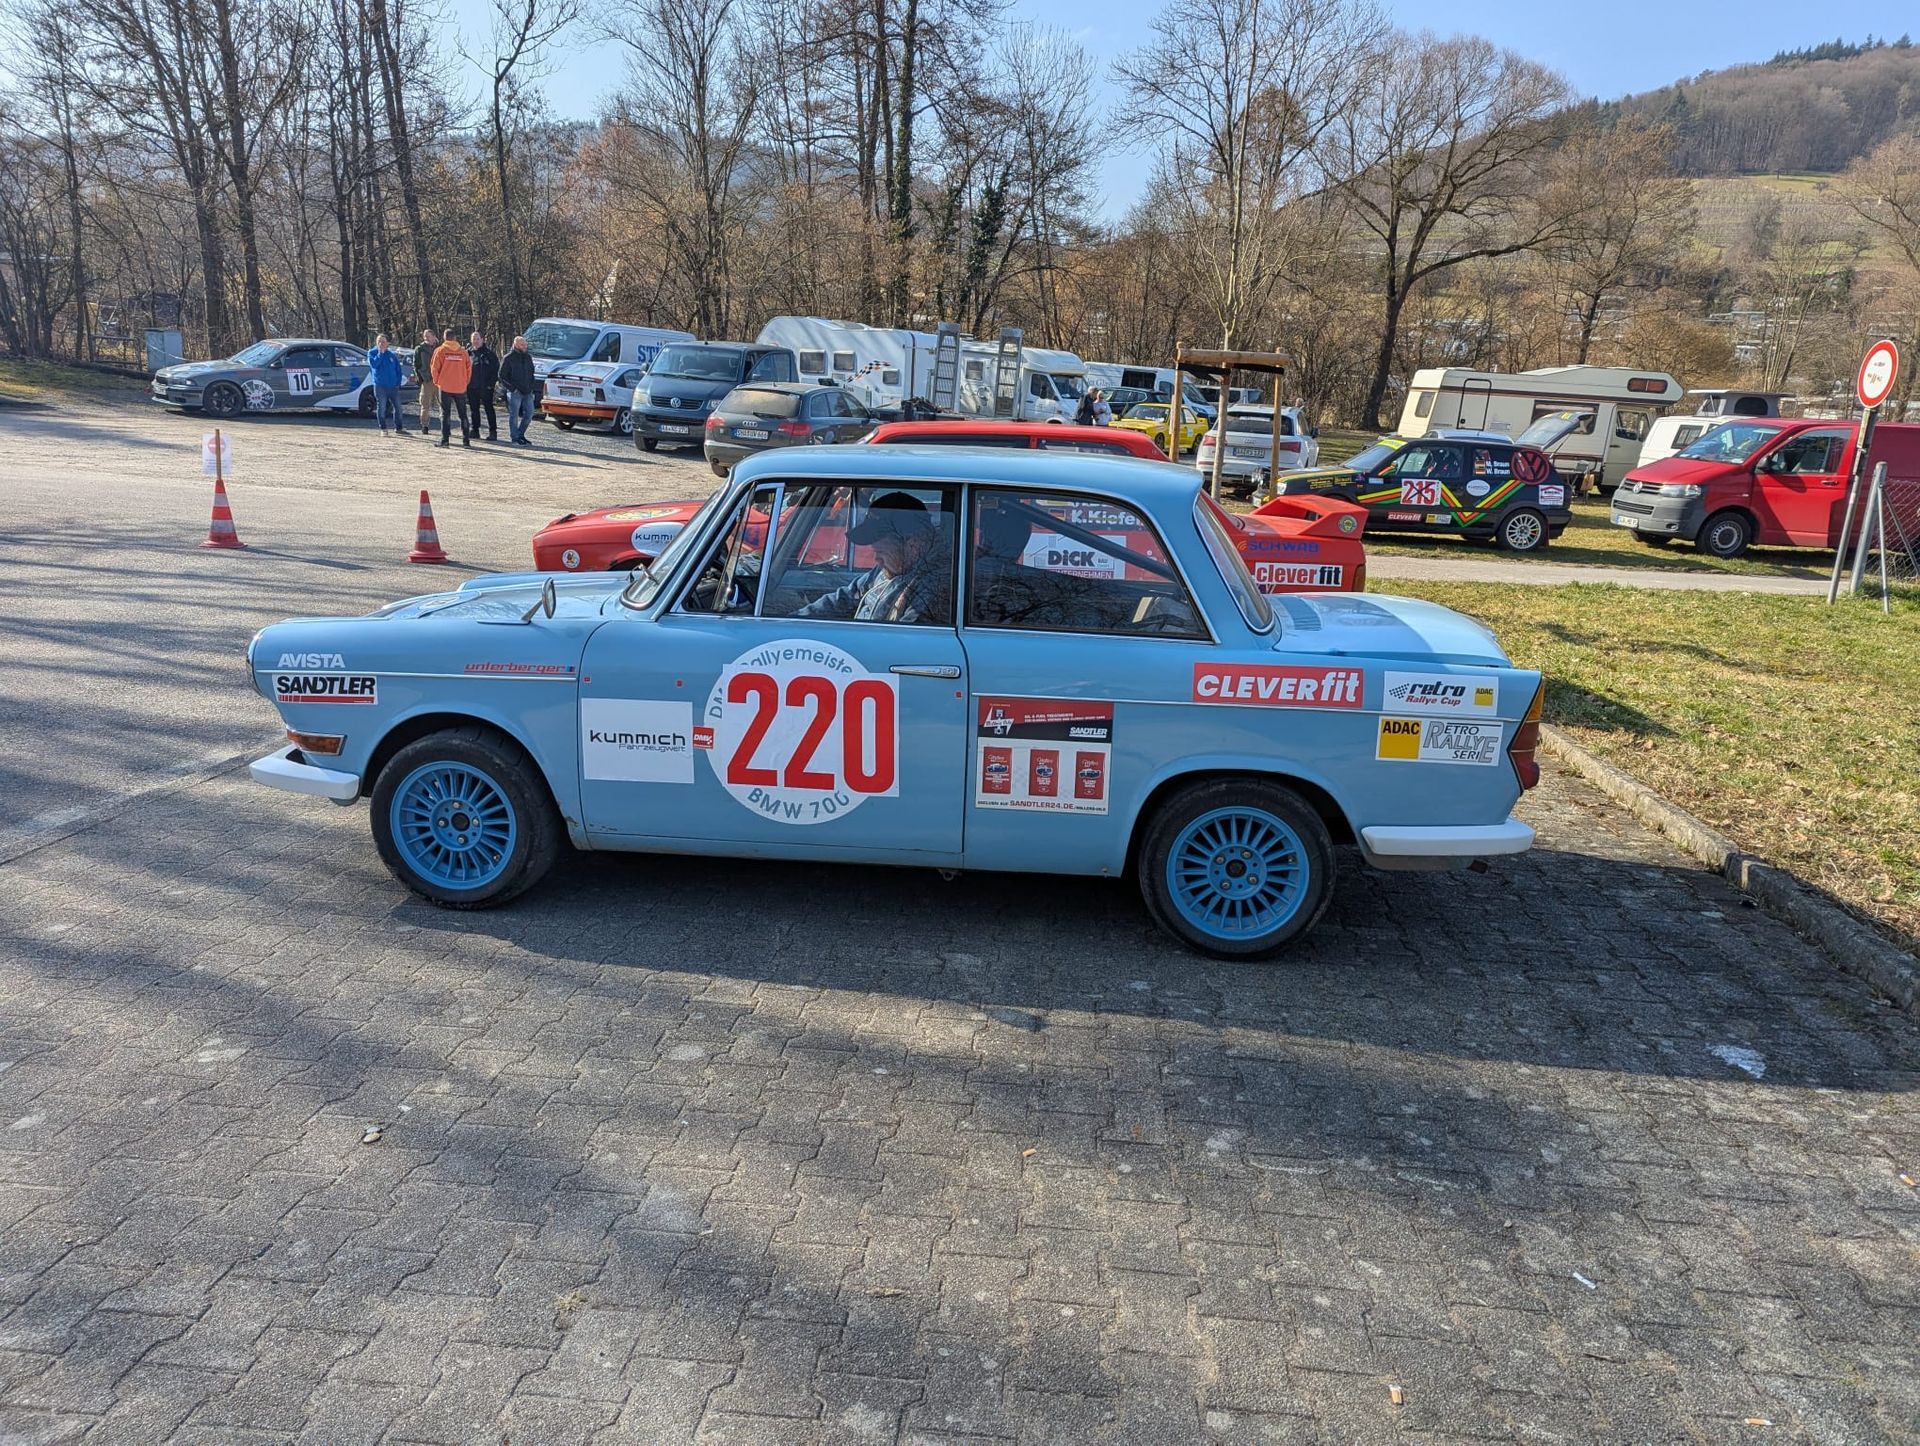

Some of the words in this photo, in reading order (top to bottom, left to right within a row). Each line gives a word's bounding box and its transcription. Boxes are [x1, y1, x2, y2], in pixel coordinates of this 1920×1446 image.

[294, 374, 309, 391] 10
[1402, 480, 1437, 506] 215
[1248, 541, 1319, 553] SCHWAB
[278, 653, 346, 668] AVISTA
[277, 676, 376, 694] SANDTLER
[1409, 681, 1466, 697] retro
[1405, 695, 1437, 705] Rallye
[1440, 696, 1461, 706] Cup
[727, 672, 895, 793] 220
[1069, 727, 1107, 735] SANDTLER
[1383, 721, 1420, 735] ADAC
[590, 730, 686, 746] kummich
[747, 787, 802, 819] BMW
[1010, 801, 1074, 809] SANDTLER24.DE
